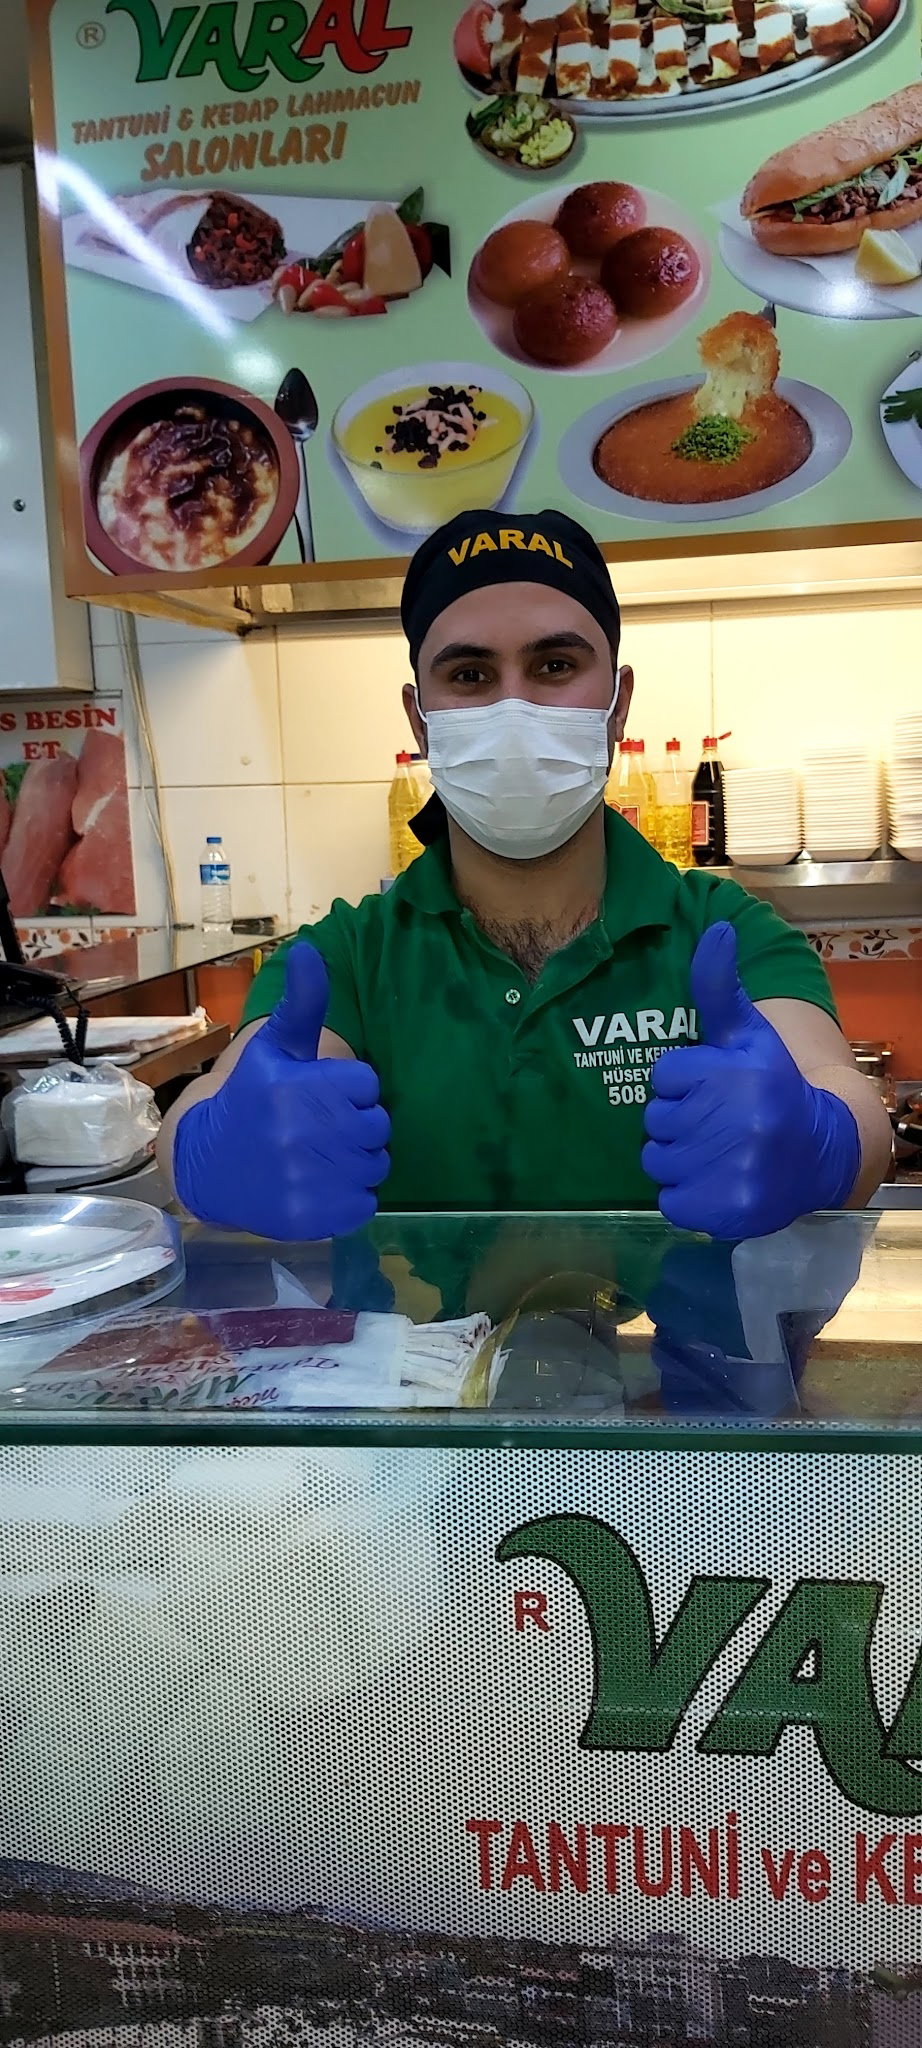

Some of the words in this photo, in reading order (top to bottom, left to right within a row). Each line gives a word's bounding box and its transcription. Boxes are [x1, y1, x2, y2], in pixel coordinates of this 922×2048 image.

[106, 0, 412, 92] VARAL
[72, 105, 171, 144] TANTUNİ
[178, 108, 193, 131] &
[202, 97, 279, 129] KEBAP
[287, 80, 422, 117] LAHMACUN
[140, 121, 348, 182] SALONLARI
[447, 529, 573, 569] VARAL
[25, 703, 116, 730] BESİN
[23, 741, 61, 760] ET
[573, 1045, 625, 1068] TANTUNİ
[626, 1048, 643, 1064] VE
[608, 1084, 647, 1106] 508
[495, 1512, 922, 1817] VA
[465, 1811, 740, 1900] TANTUNİ
[761, 1847, 832, 1902] ve
